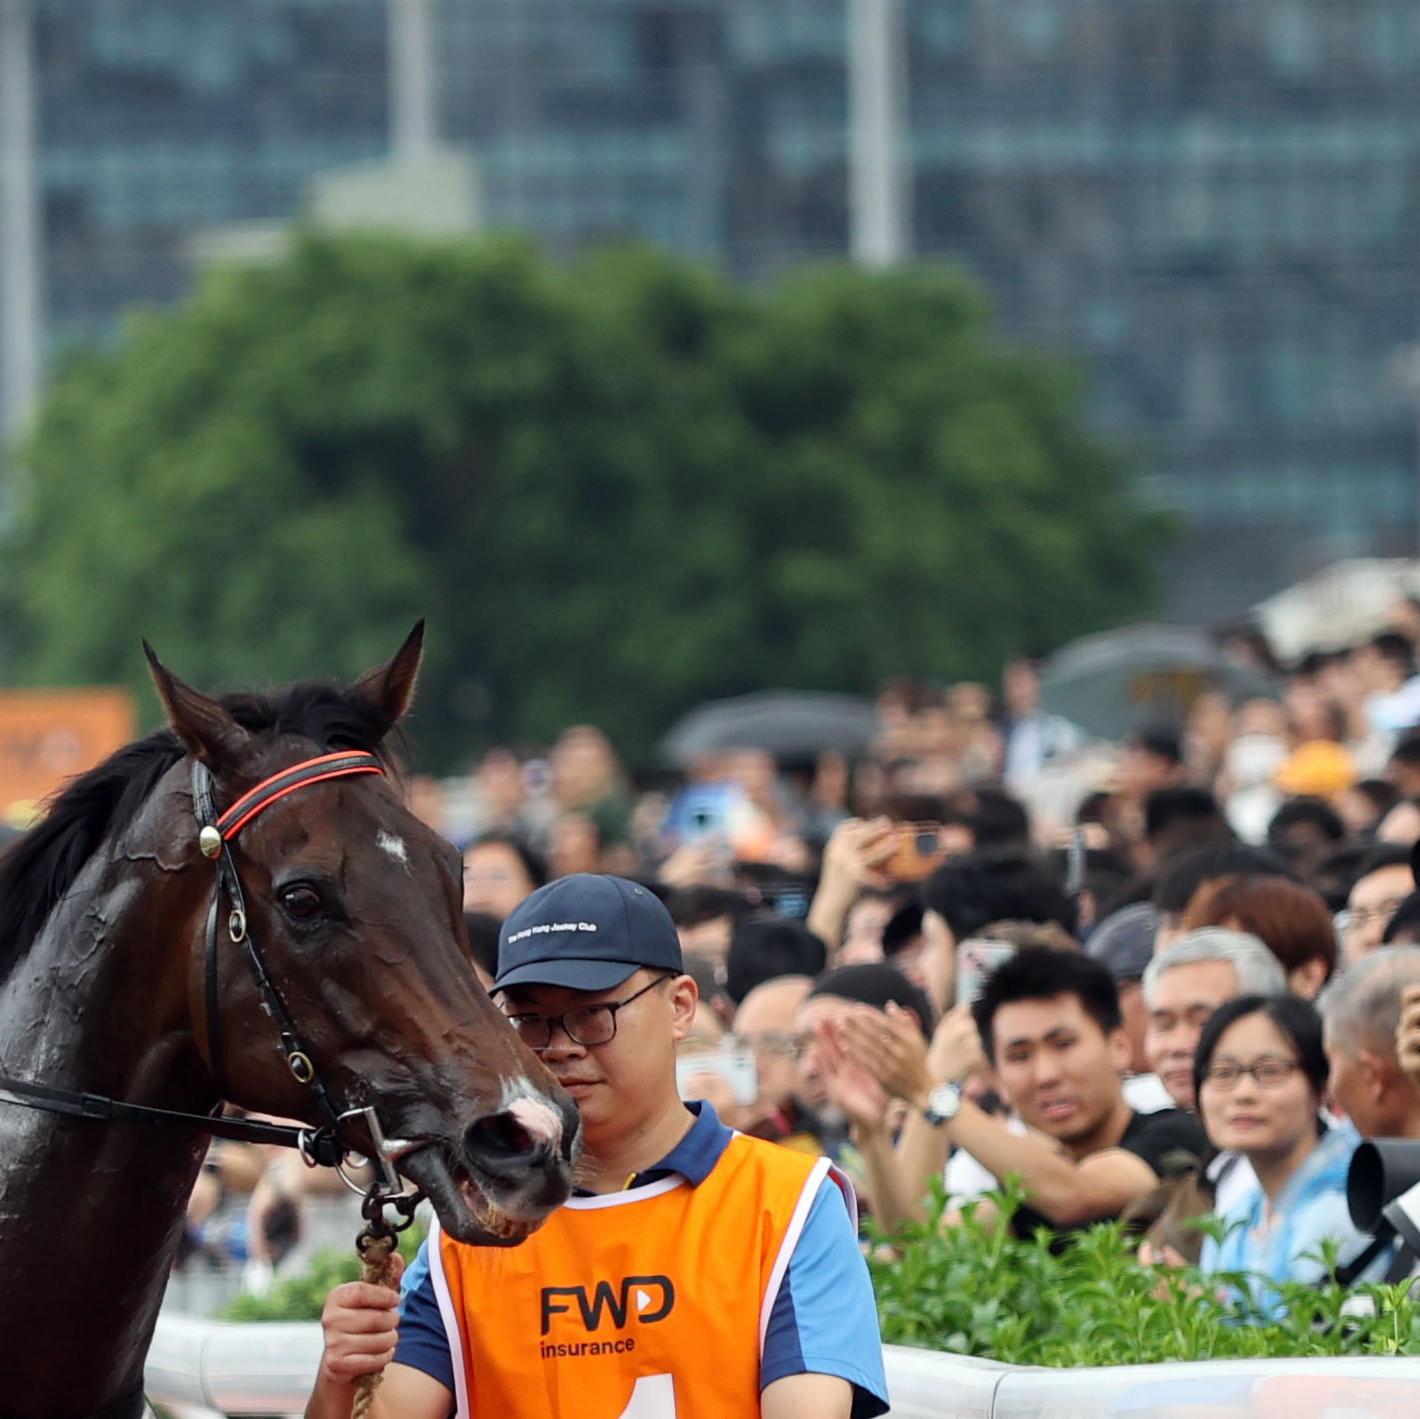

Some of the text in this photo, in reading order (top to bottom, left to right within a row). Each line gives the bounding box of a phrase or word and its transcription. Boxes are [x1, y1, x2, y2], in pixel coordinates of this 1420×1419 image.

[517, 929, 531, 939] Hong
[532, 925, 550, 933] Kong
[551, 923, 577, 931] Jockey
[578, 922, 596, 931] Club
[540, 1274, 676, 1337] FWD
[540, 1338, 636, 1360] insurance
